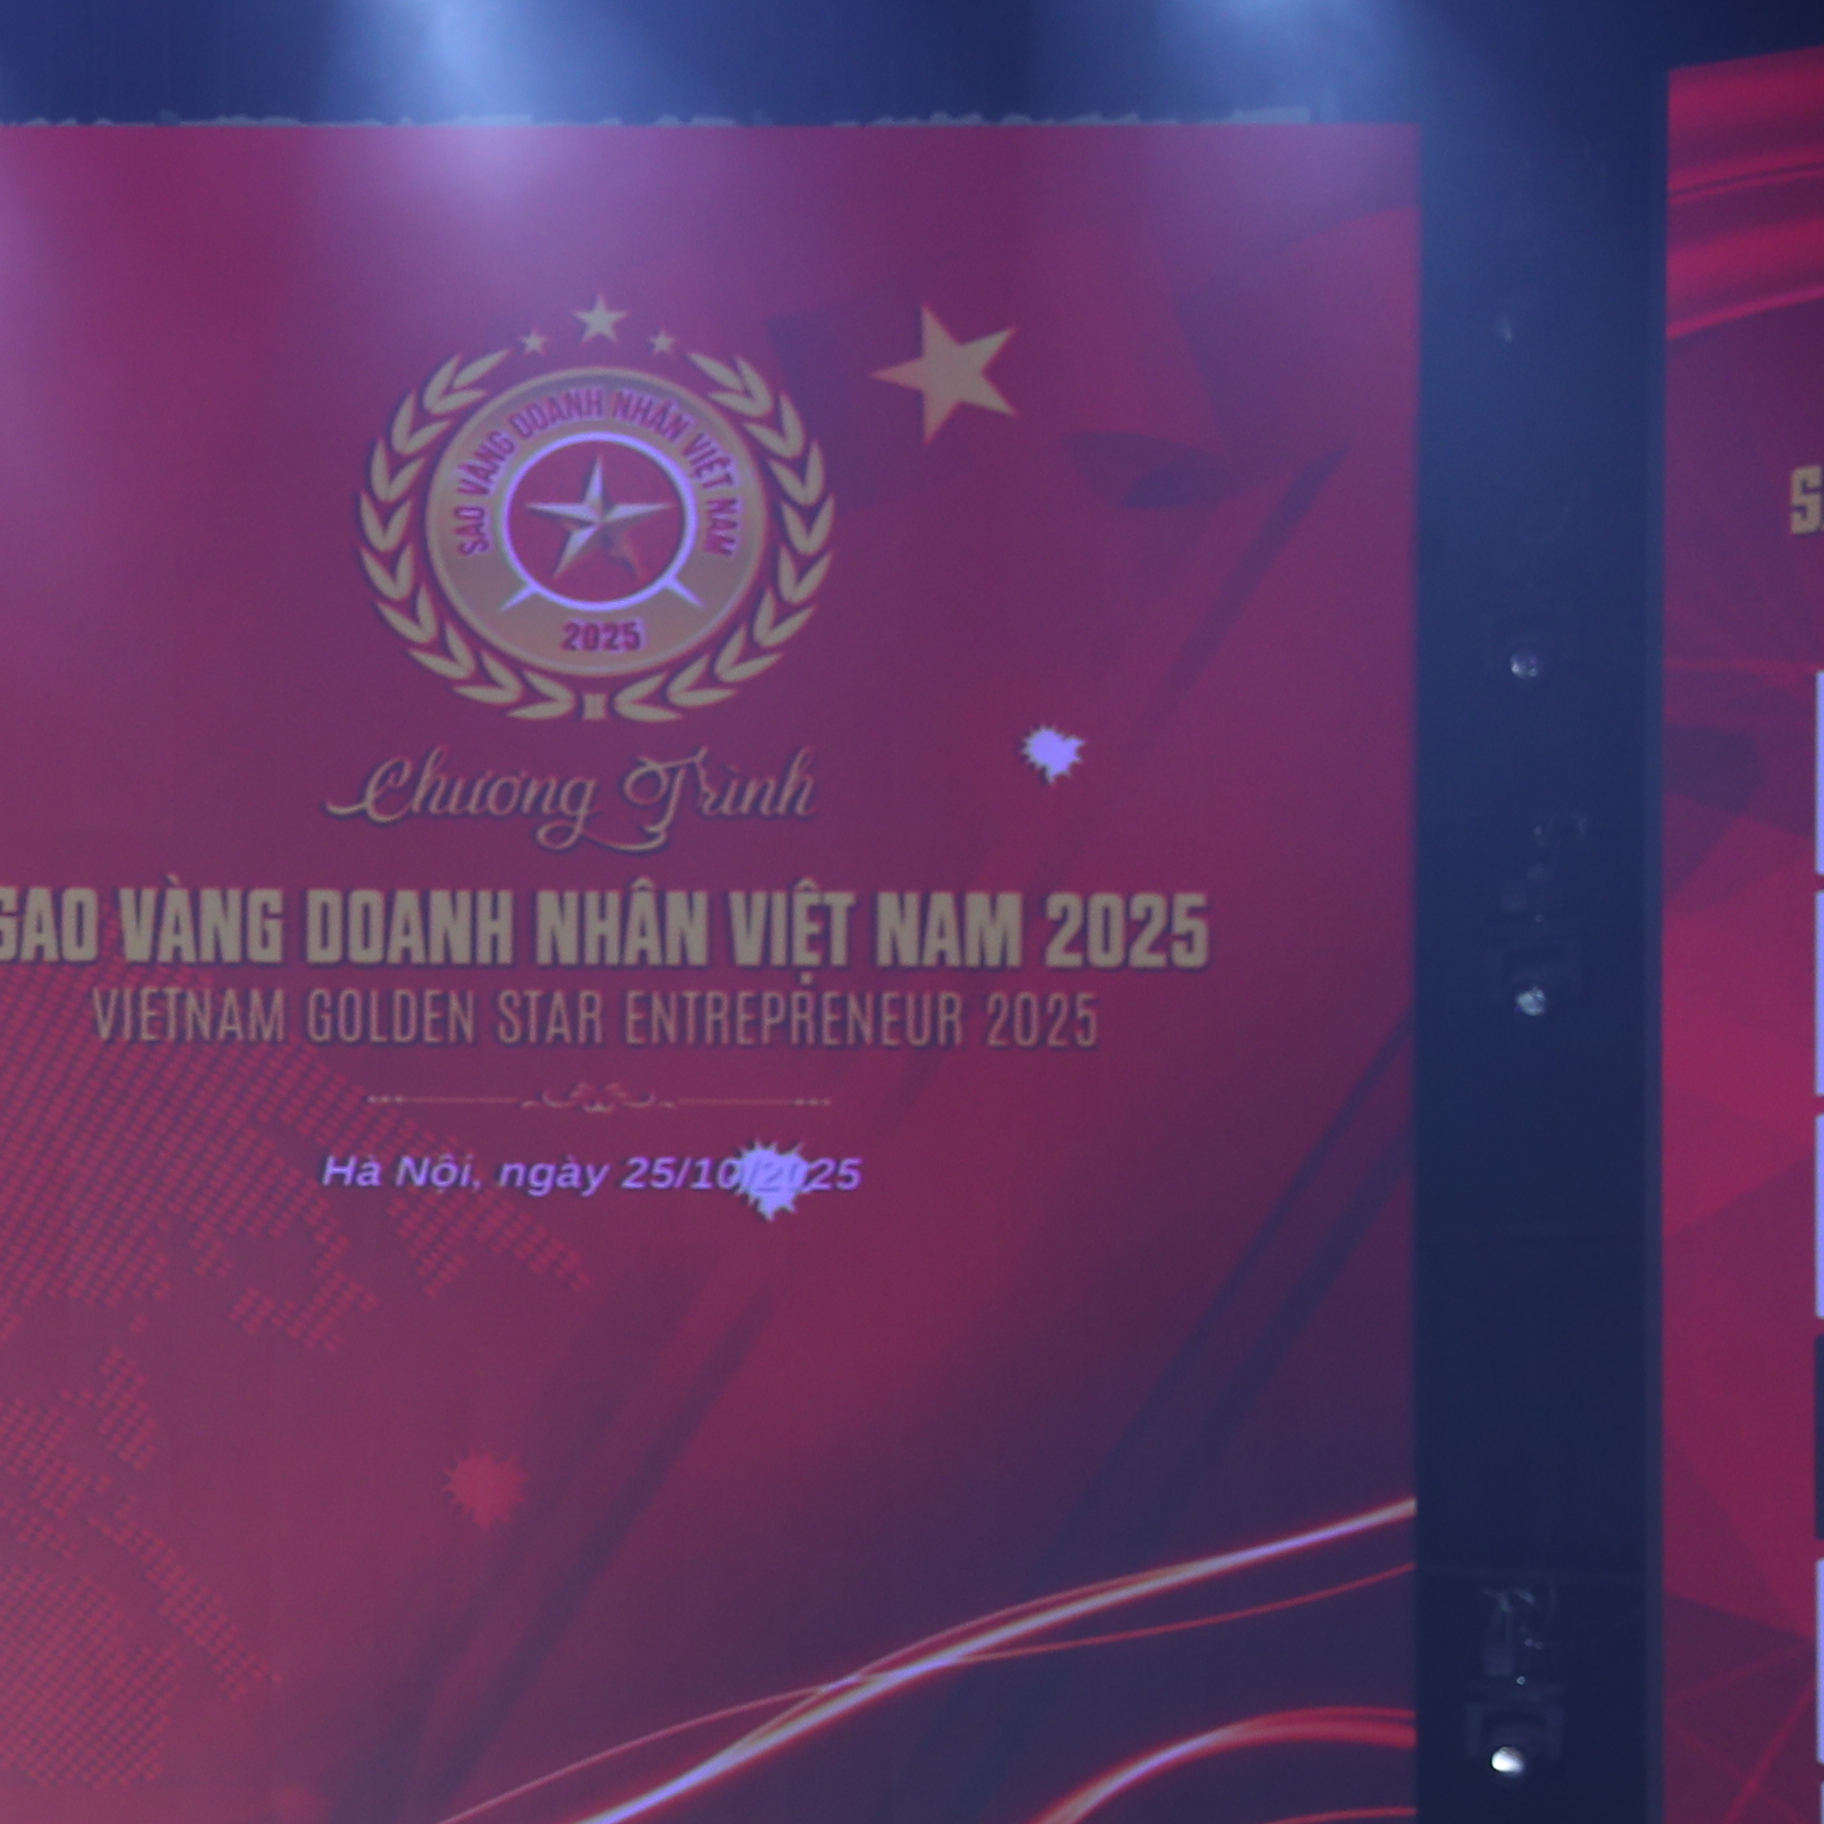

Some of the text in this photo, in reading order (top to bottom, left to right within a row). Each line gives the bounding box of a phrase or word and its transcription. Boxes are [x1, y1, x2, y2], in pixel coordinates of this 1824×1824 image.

[508, 388, 605, 440] DOANH
[611, 389, 695, 443] NHÂN
[457, 430, 515, 497] VÀNG
[704, 496, 741, 558] NAM
[1790, 465, 1824, 534] S
[455, 504, 491, 557] SAO
[562, 619, 645, 652] 2025
[325, 745, 816, 852] Chương Trình
[119, 874, 283, 964] VÀNG
[306, 889, 514, 965] DOANH
[536, 877, 708, 967] NHÂN
[729, 878, 856, 985] VIỆT
[876, 891, 1022, 968] NAM
[1045, 892, 1209, 969] 2025
[92, 987, 1098, 1047] VIETNAM GOLDEN STAR ENTREPRENEUR 2025
[322, 1153, 381, 1187] Hà
[396, 1154, 481, 1193] Nội,
[500, 1154, 610, 1196] ngày
